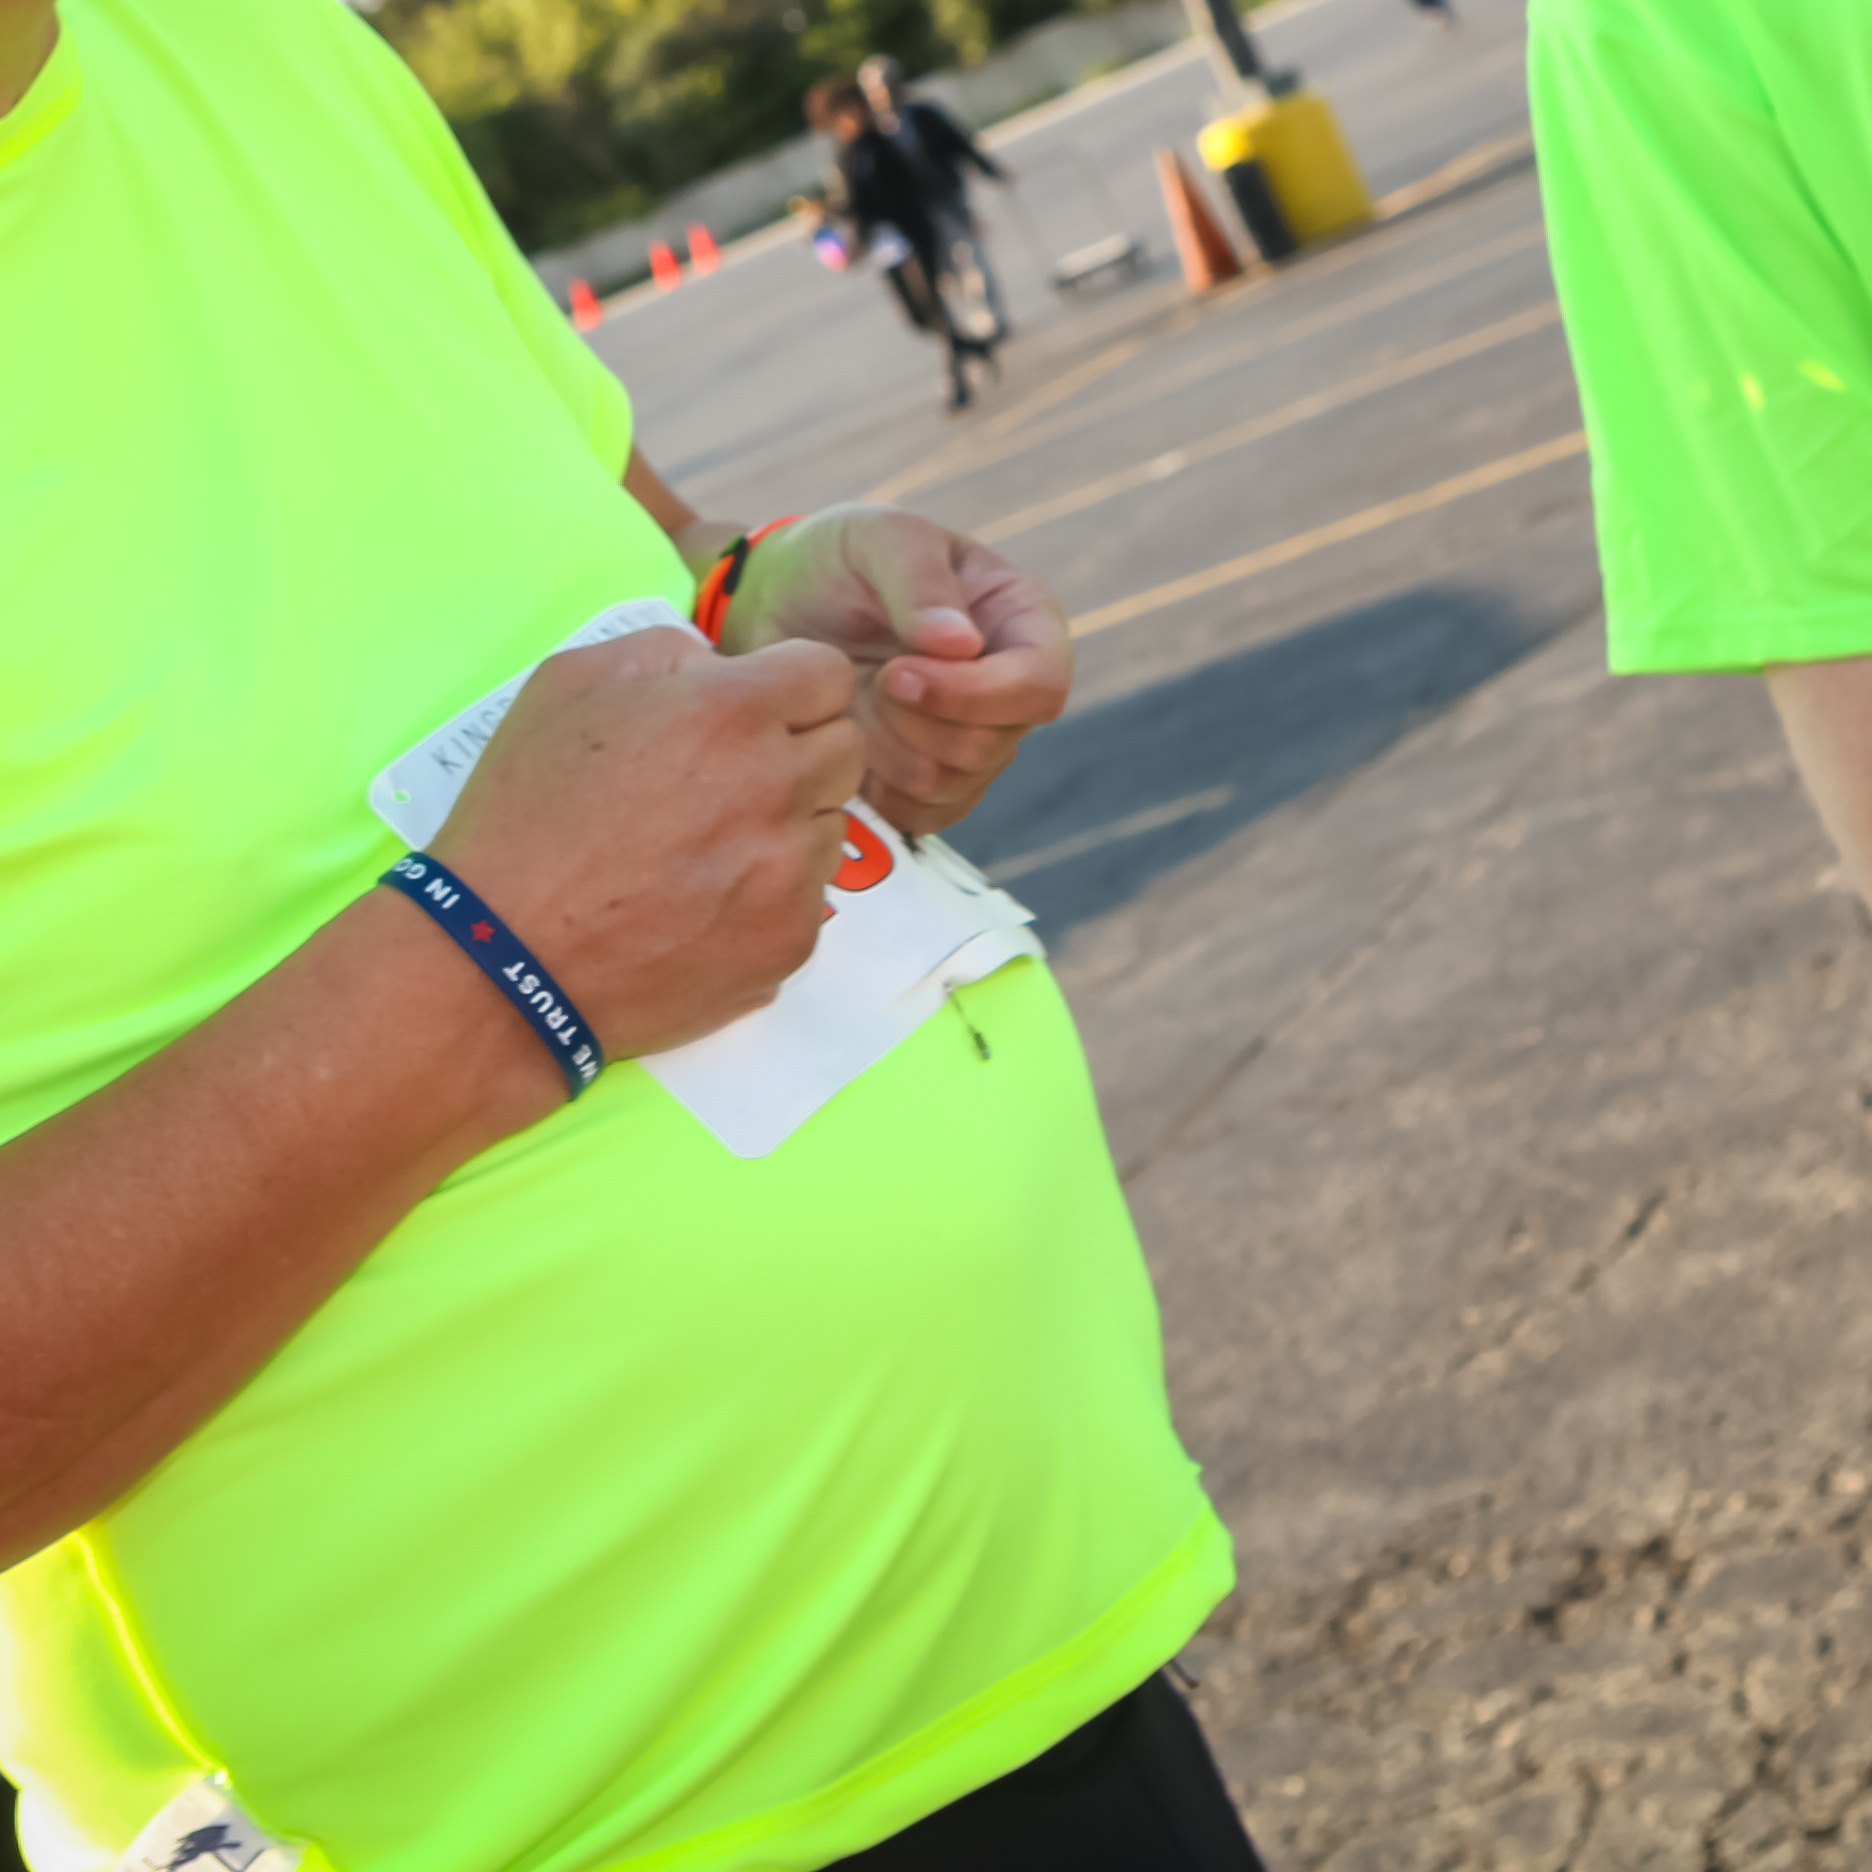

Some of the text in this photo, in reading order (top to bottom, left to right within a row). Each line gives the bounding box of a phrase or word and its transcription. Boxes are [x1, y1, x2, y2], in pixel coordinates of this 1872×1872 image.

[392, 857, 428, 880] GO
[424, 877, 461, 910] IN
[502, 961, 578, 1046] TRUST
